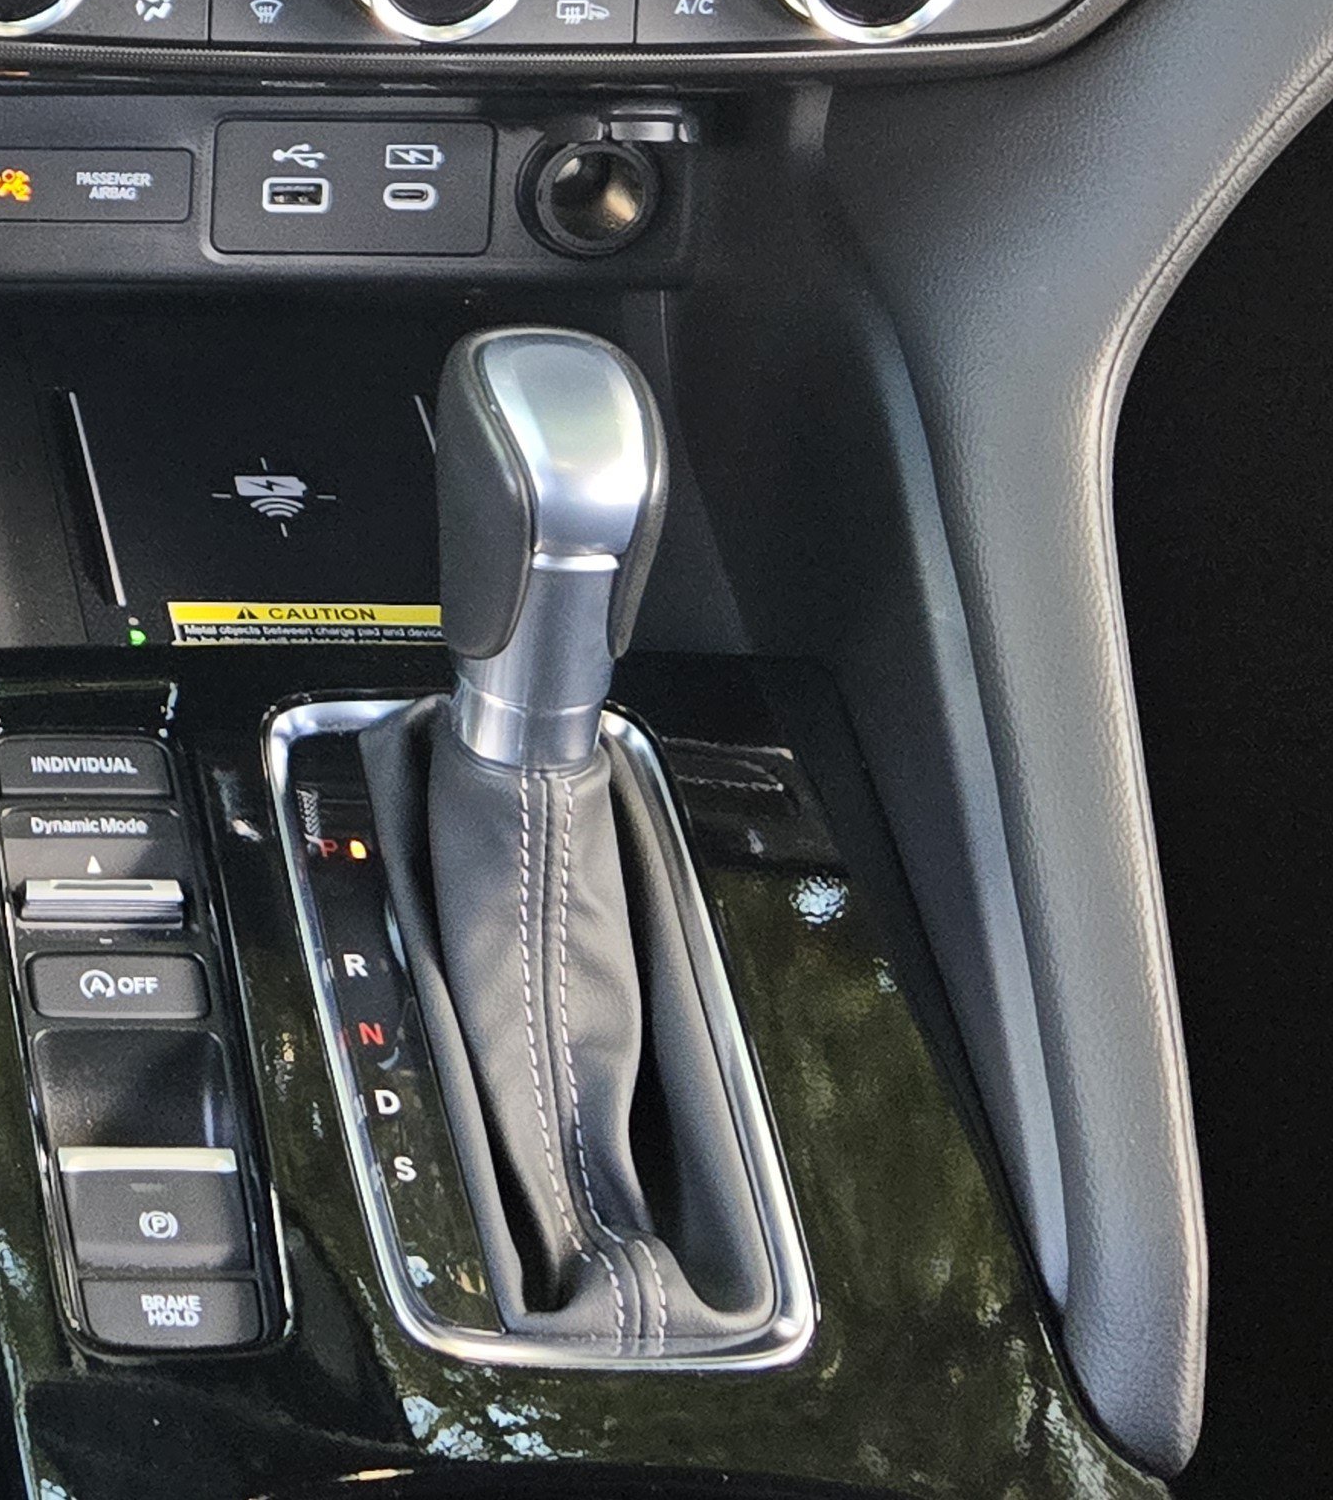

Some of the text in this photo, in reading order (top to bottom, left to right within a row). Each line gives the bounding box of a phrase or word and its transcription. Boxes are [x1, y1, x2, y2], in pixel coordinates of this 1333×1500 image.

[76, 172, 151, 187] PASSENGER
[90, 186, 136, 201] AIRBAG
[268, 607, 376, 621] CAUTION
[263, 626, 313, 636] between
[31, 756, 138, 774] INDIVIDUAL
[31, 816, 148, 836] Dynamic Mode
[321, 840, 338, 857] P
[343, 953, 369, 977] R
[118, 976, 159, 995] OFF
[359, 1023, 384, 1045] N
[375, 1090, 401, 1114] D
[394, 1157, 416, 1182] S
[141, 1295, 201, 1311] BRAKE
[148, 1310, 199, 1328] HOLD
